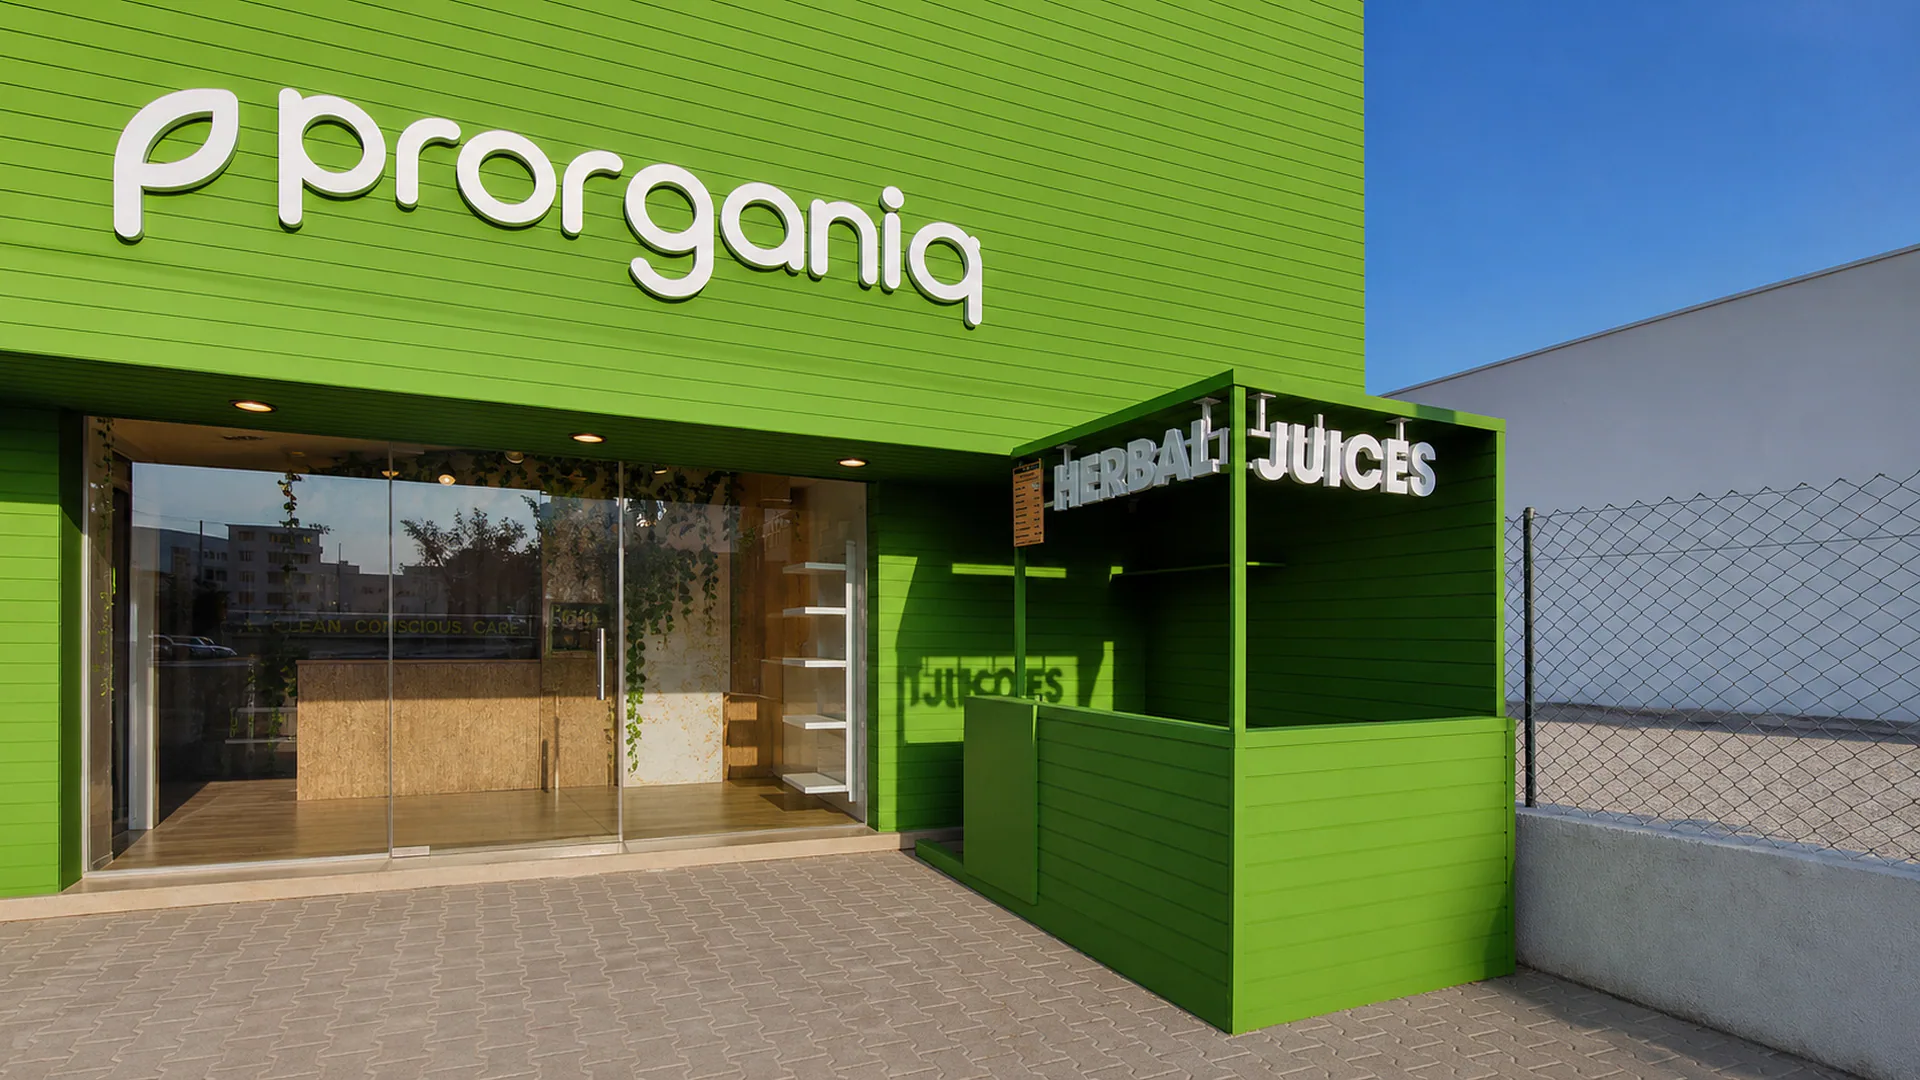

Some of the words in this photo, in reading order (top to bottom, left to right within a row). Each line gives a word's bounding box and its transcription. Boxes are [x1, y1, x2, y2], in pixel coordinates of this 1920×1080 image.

[278, 87, 983, 326] prorganiq
[1053, 418, 1220, 511] HERBAL
[1252, 421, 1437, 497] JUICES
